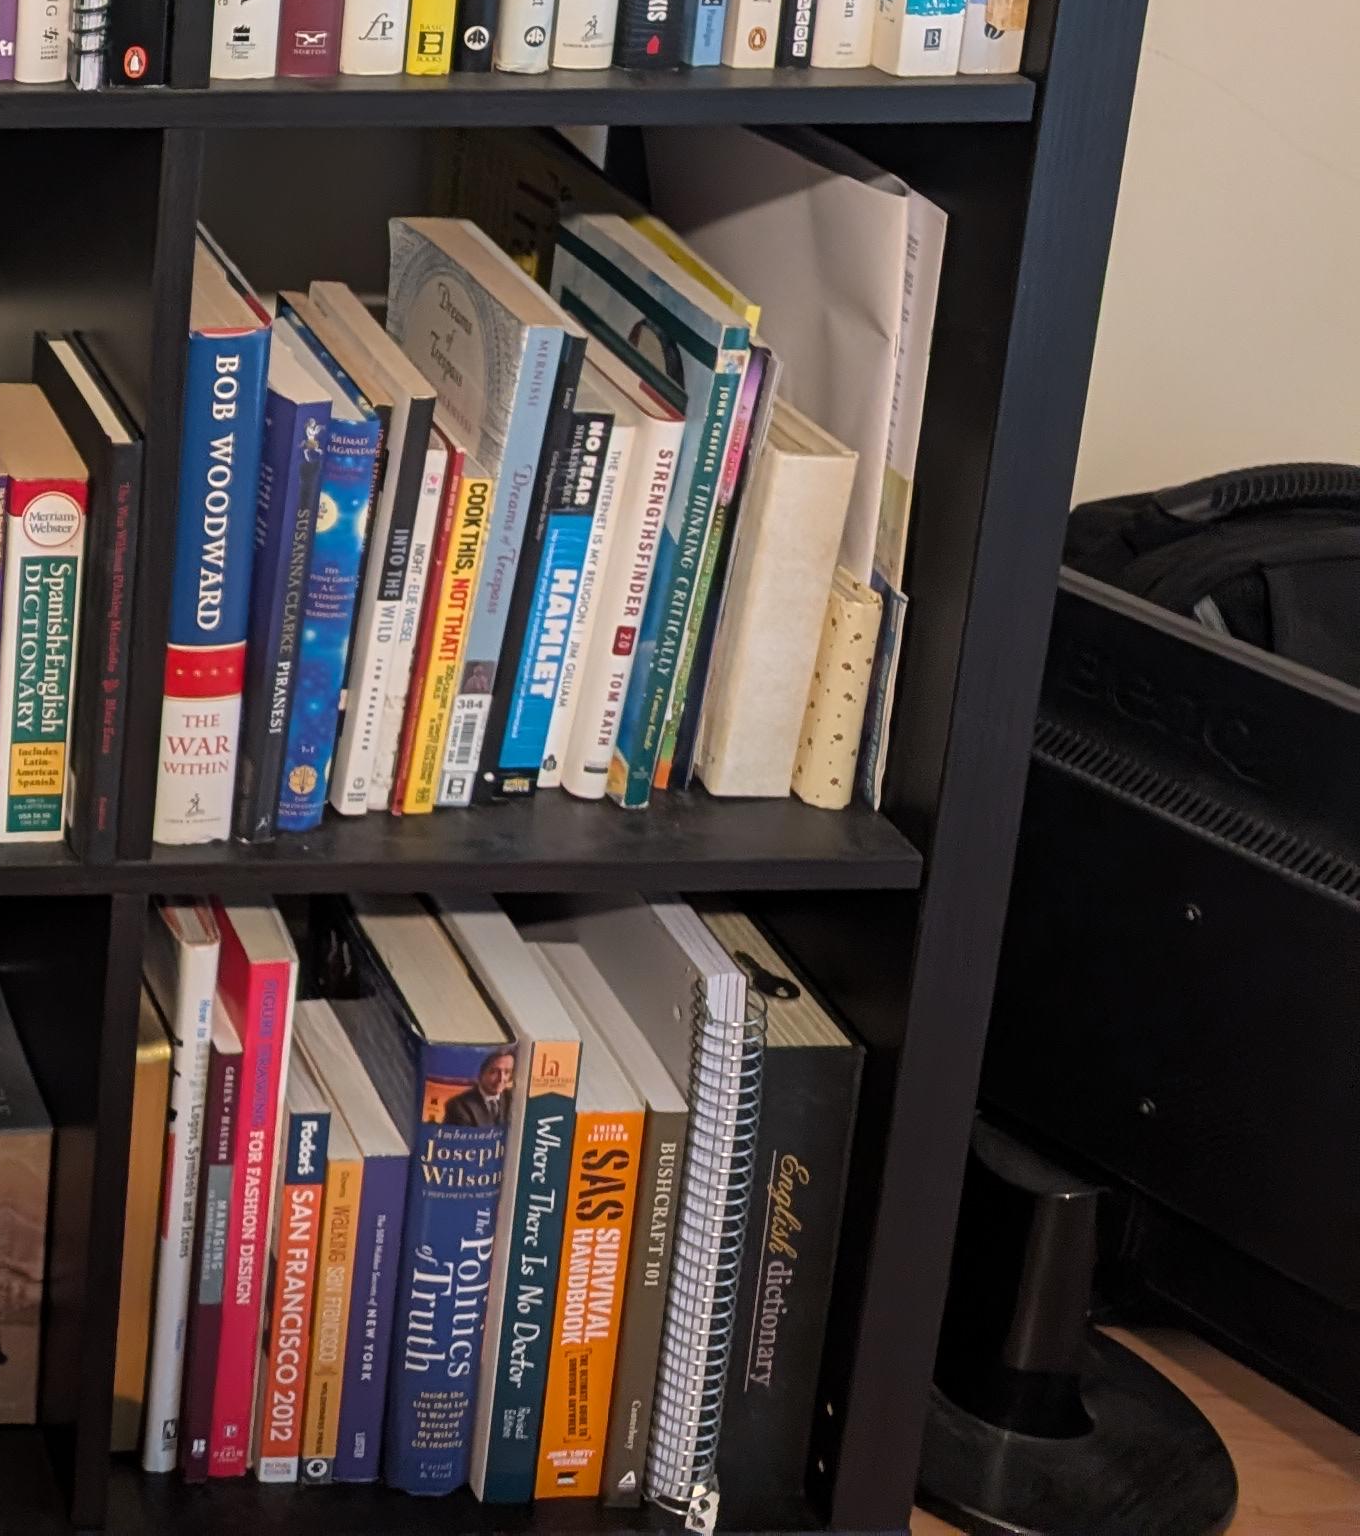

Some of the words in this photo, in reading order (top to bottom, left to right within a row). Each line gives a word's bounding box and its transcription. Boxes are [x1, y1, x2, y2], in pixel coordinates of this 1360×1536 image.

[215, 354, 240, 421] BOB
[30, 523, 73, 534] Webster
[196, 433, 235, 631] WOODWARD
[623, 449, 675, 617] STRENGTHSFINDER
[16, 564, 41, 733] DICTIONARY
[530, 568, 576, 700] HAMLET
[163, 759, 230, 775] WITHIN
[167, 735, 231, 756] WAR
[181, 713, 220, 728] THE
[576, 1149, 629, 1222] SAS
[768, 1154, 810, 1257] English
[561, 1228, 589, 1345] HANDBOOK
[585, 1228, 621, 1343] SURVIVAL
[752, 1259, 791, 1388] dictionary
